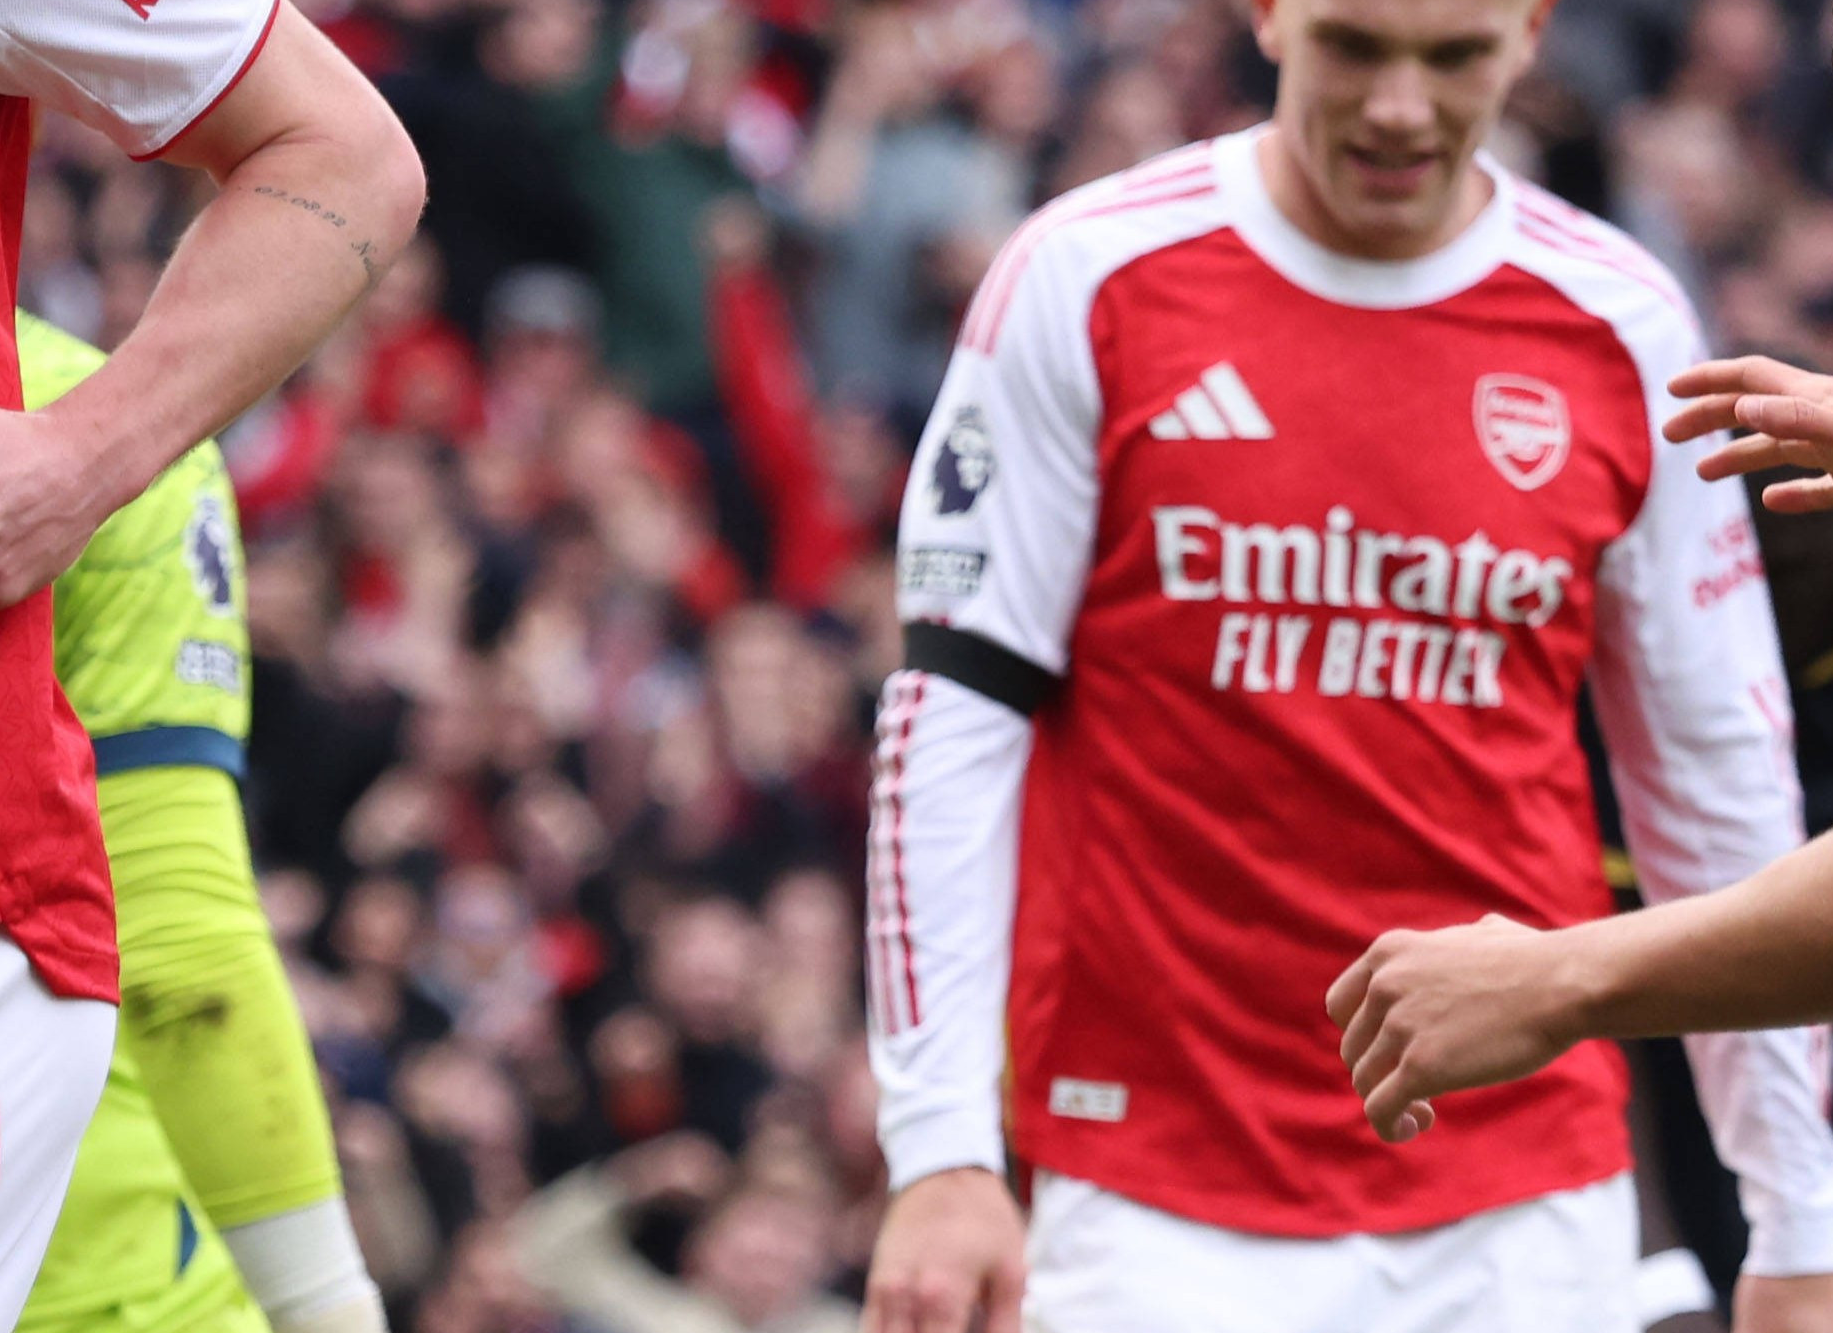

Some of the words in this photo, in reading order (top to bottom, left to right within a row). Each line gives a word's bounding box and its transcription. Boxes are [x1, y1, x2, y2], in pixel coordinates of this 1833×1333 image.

[1150, 504, 1574, 629] Emirates
[1210, 611, 1313, 694] FLY
[1318, 616, 1507, 709] BETTER
